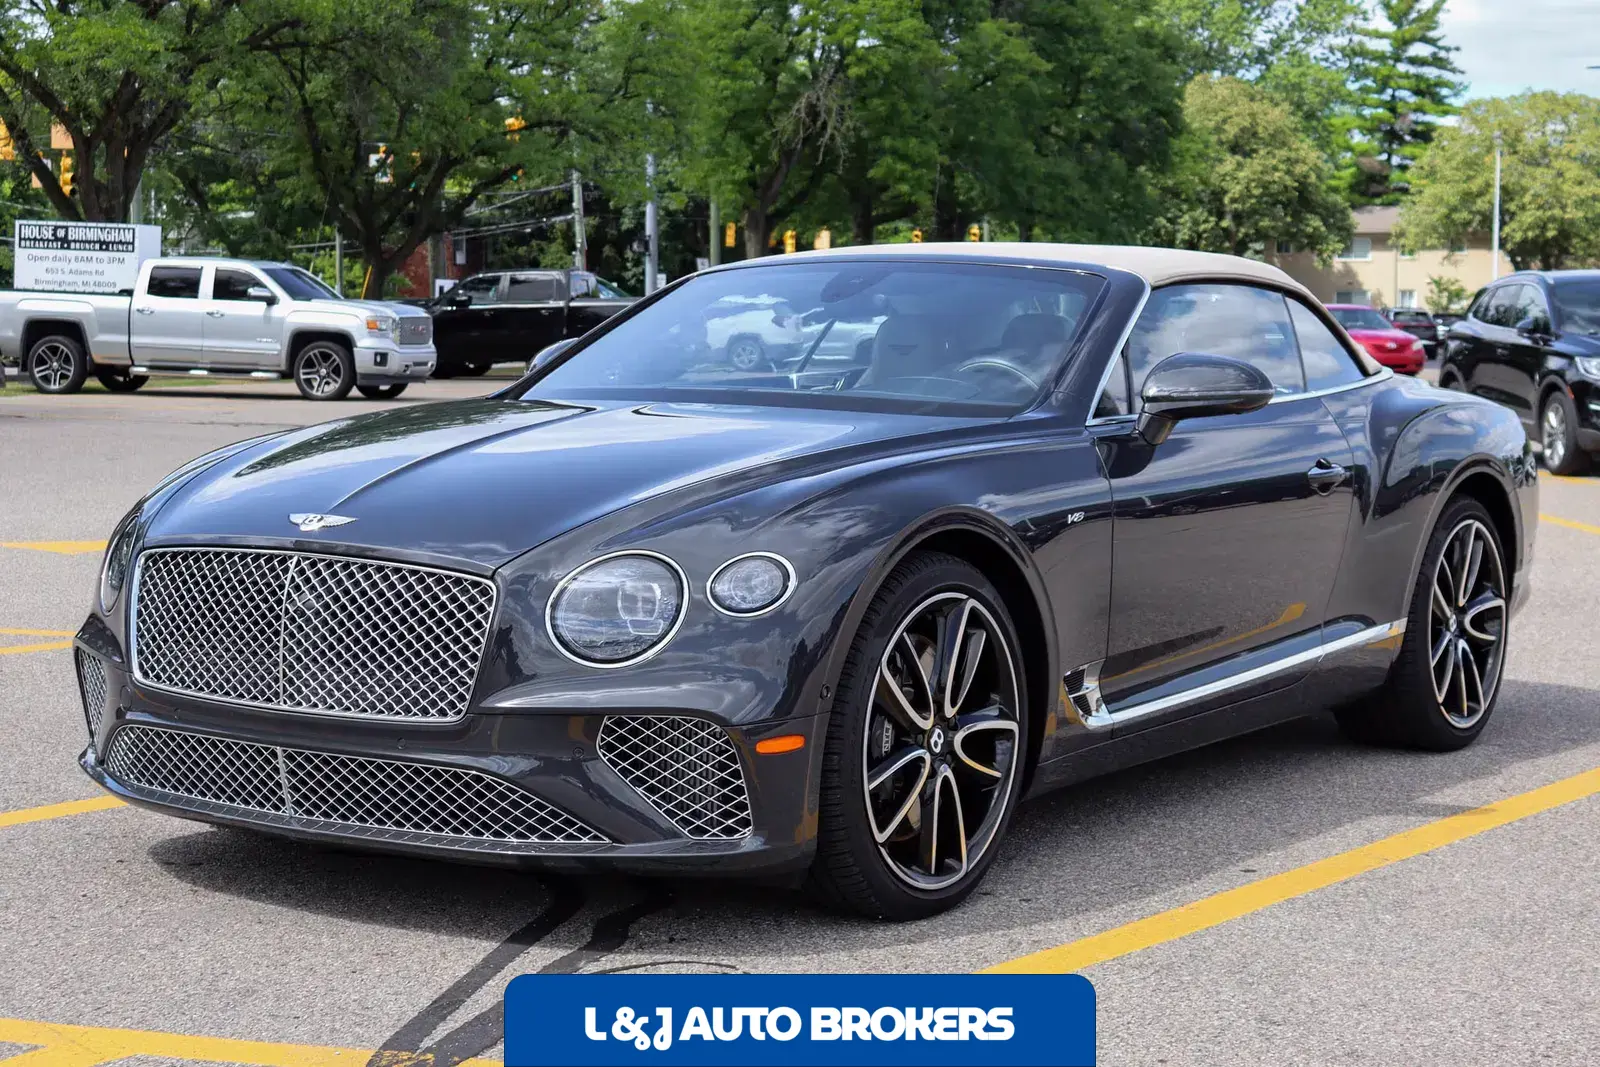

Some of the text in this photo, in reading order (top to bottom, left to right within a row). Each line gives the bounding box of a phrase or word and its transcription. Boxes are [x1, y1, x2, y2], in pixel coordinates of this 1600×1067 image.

[21, 225, 55, 240] HOUSE
[68, 227, 134, 242] BIRMINGHAM
[27, 254, 126, 264] Open daily 8AM to 3PM
[68, 268, 93, 276] Adams
[34, 278, 80, 288] Birmingham,
[1067, 511, 1085, 525] V8
